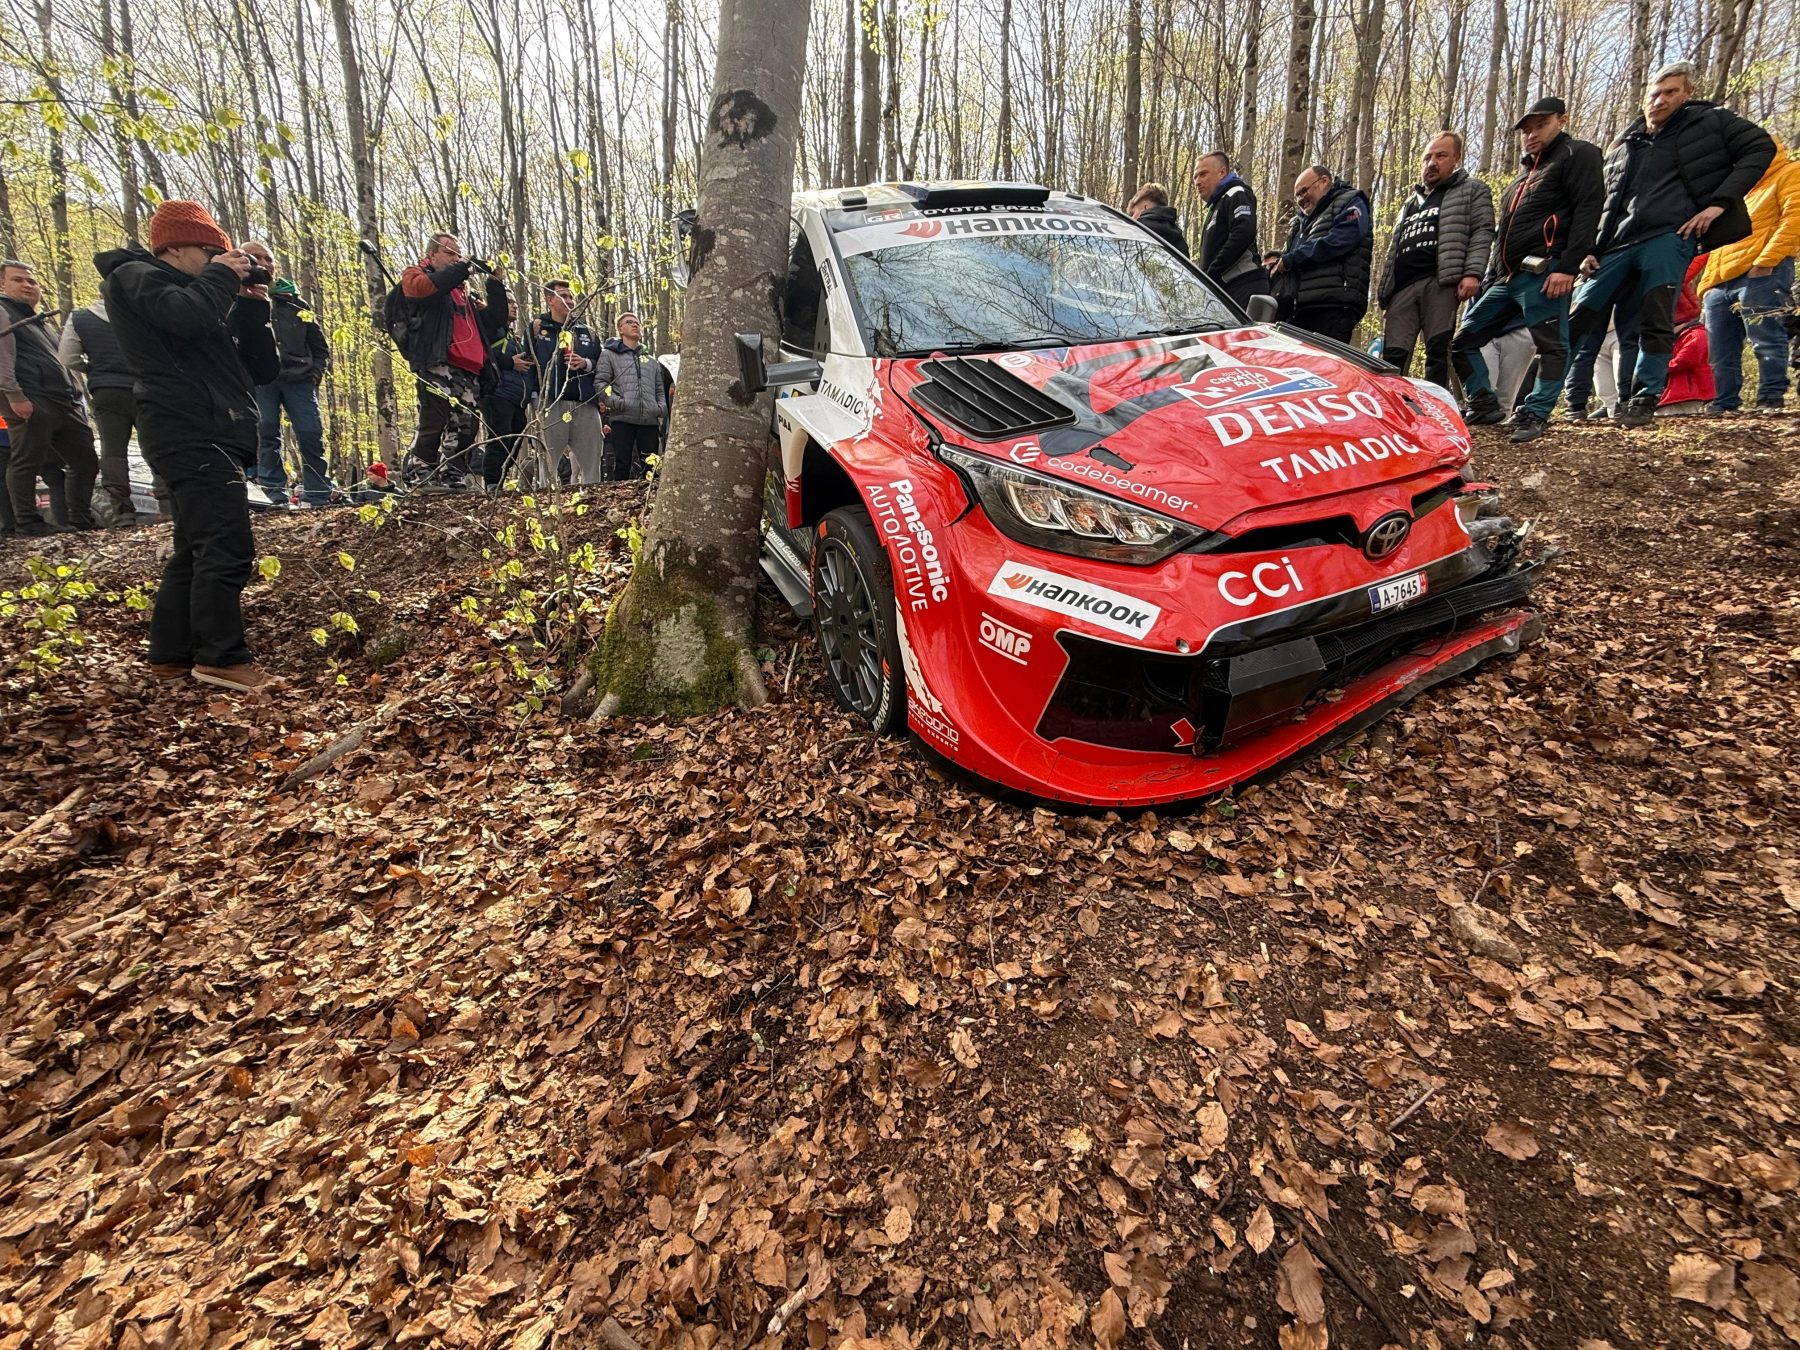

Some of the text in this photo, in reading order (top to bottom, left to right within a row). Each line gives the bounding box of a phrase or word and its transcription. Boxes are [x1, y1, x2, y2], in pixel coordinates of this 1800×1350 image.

[866, 210, 901, 224] GR
[908, 204, 986, 216] TOYOTA
[990, 204, 1054, 213] GAZOO
[1209, 371, 1266, 385] CROATIA
[1233, 376, 1270, 388] RALLY
[821, 380, 864, 414] TAMADIC
[1204, 391, 1384, 447] DENSO
[1260, 433, 1420, 483] TAMADIC
[1047, 457, 1193, 512] codebeamer
[866, 485, 929, 612] AUTOMOTIVE
[889, 479, 950, 602] Panasonic
[1383, 579, 1418, 606] A-7645
[980, 619, 1031, 657] OMP
